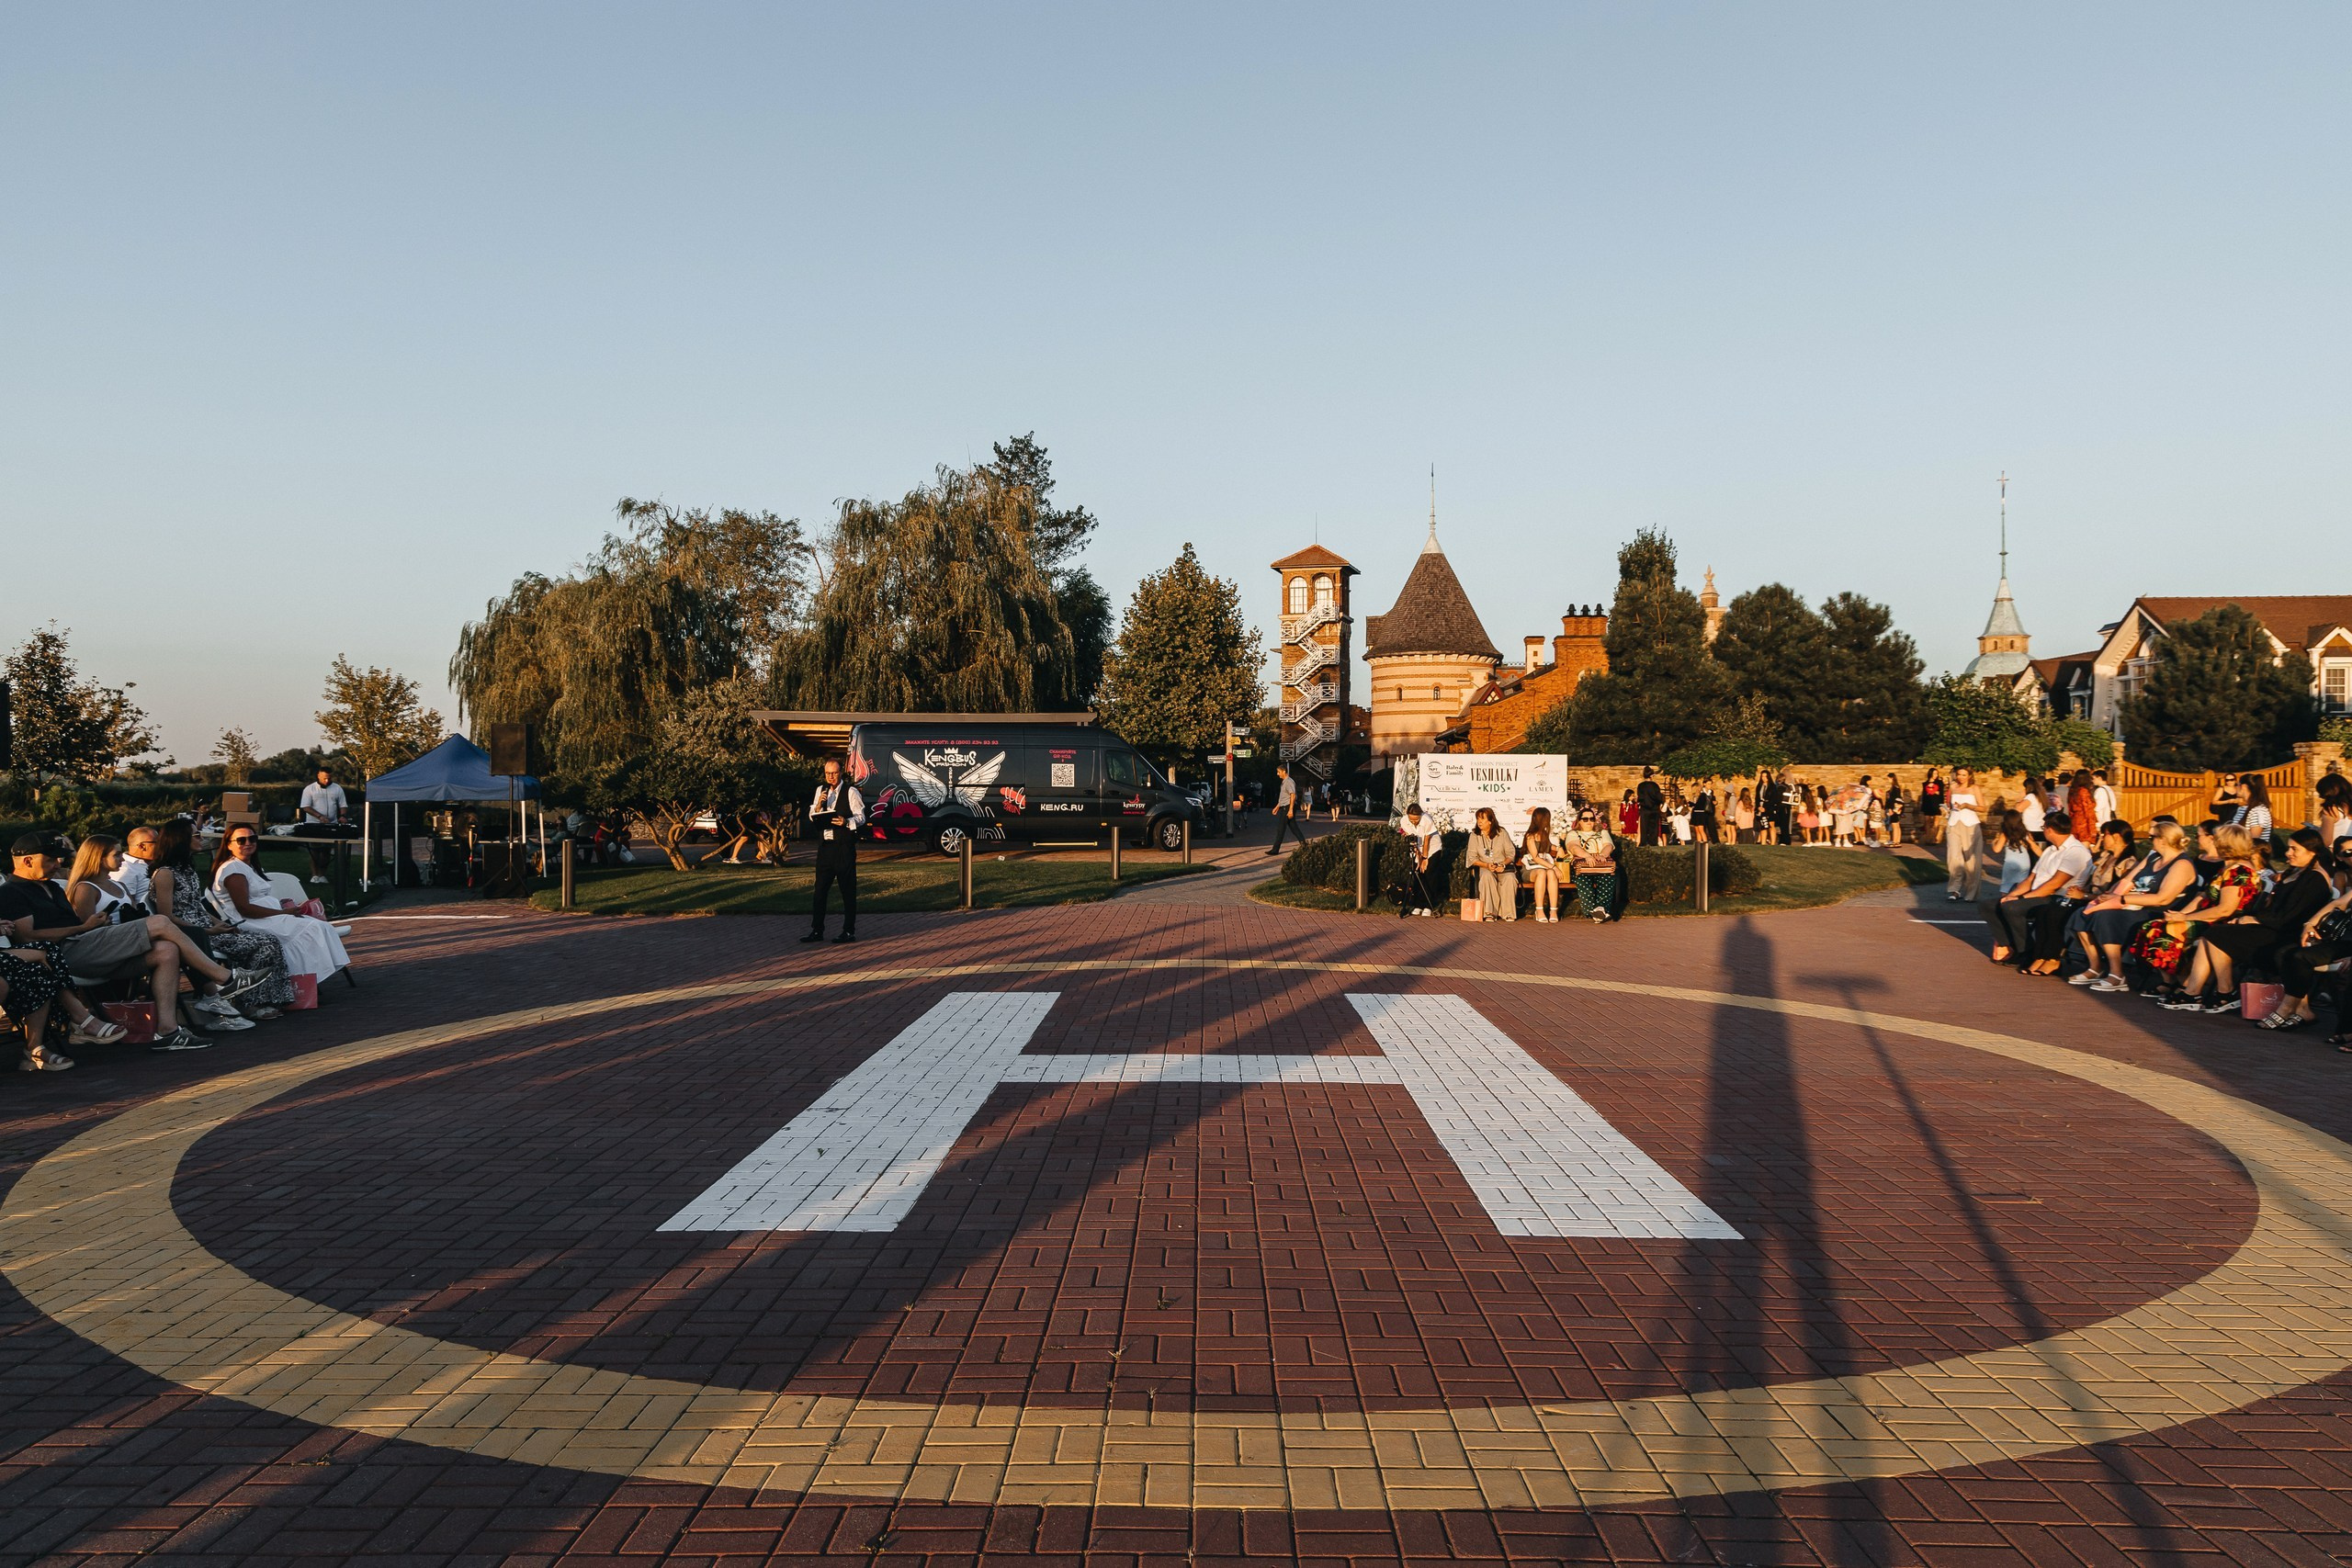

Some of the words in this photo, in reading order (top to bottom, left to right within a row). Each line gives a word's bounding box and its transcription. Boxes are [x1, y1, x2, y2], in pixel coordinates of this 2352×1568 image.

[924, 748, 977, 768] KENGBUS
[1483, 784, 1506, 793] KIDS
[1040, 803, 1084, 812] KENG.RU
